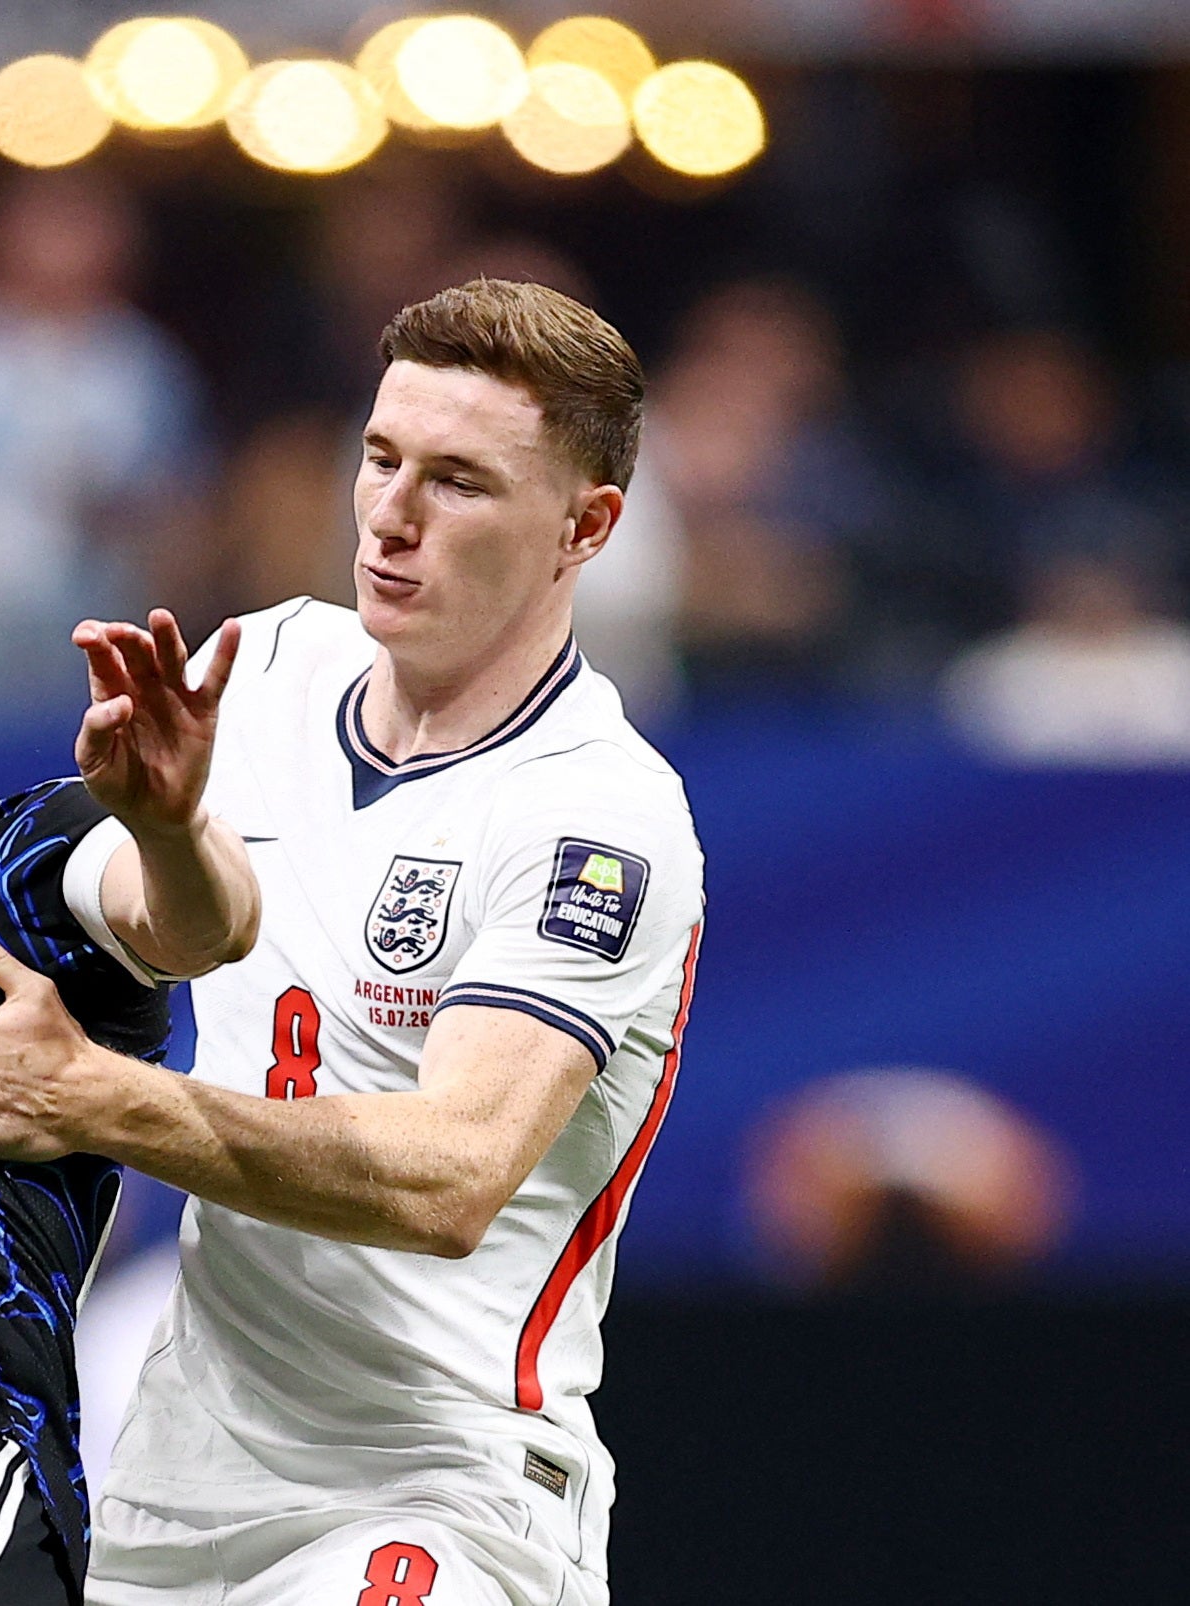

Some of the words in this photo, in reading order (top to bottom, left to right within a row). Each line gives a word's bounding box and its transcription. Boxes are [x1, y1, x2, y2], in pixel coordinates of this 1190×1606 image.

[570, 885, 604, 907] Unite
[603, 895, 622, 913] For
[556, 902, 624, 938] EDUCATION
[573, 926, 600, 942] FIFA
[368, 1006, 430, 1028] 15.07.26
[266, 985, 321, 1100] 8
[357, 1540, 439, 1606] 8
